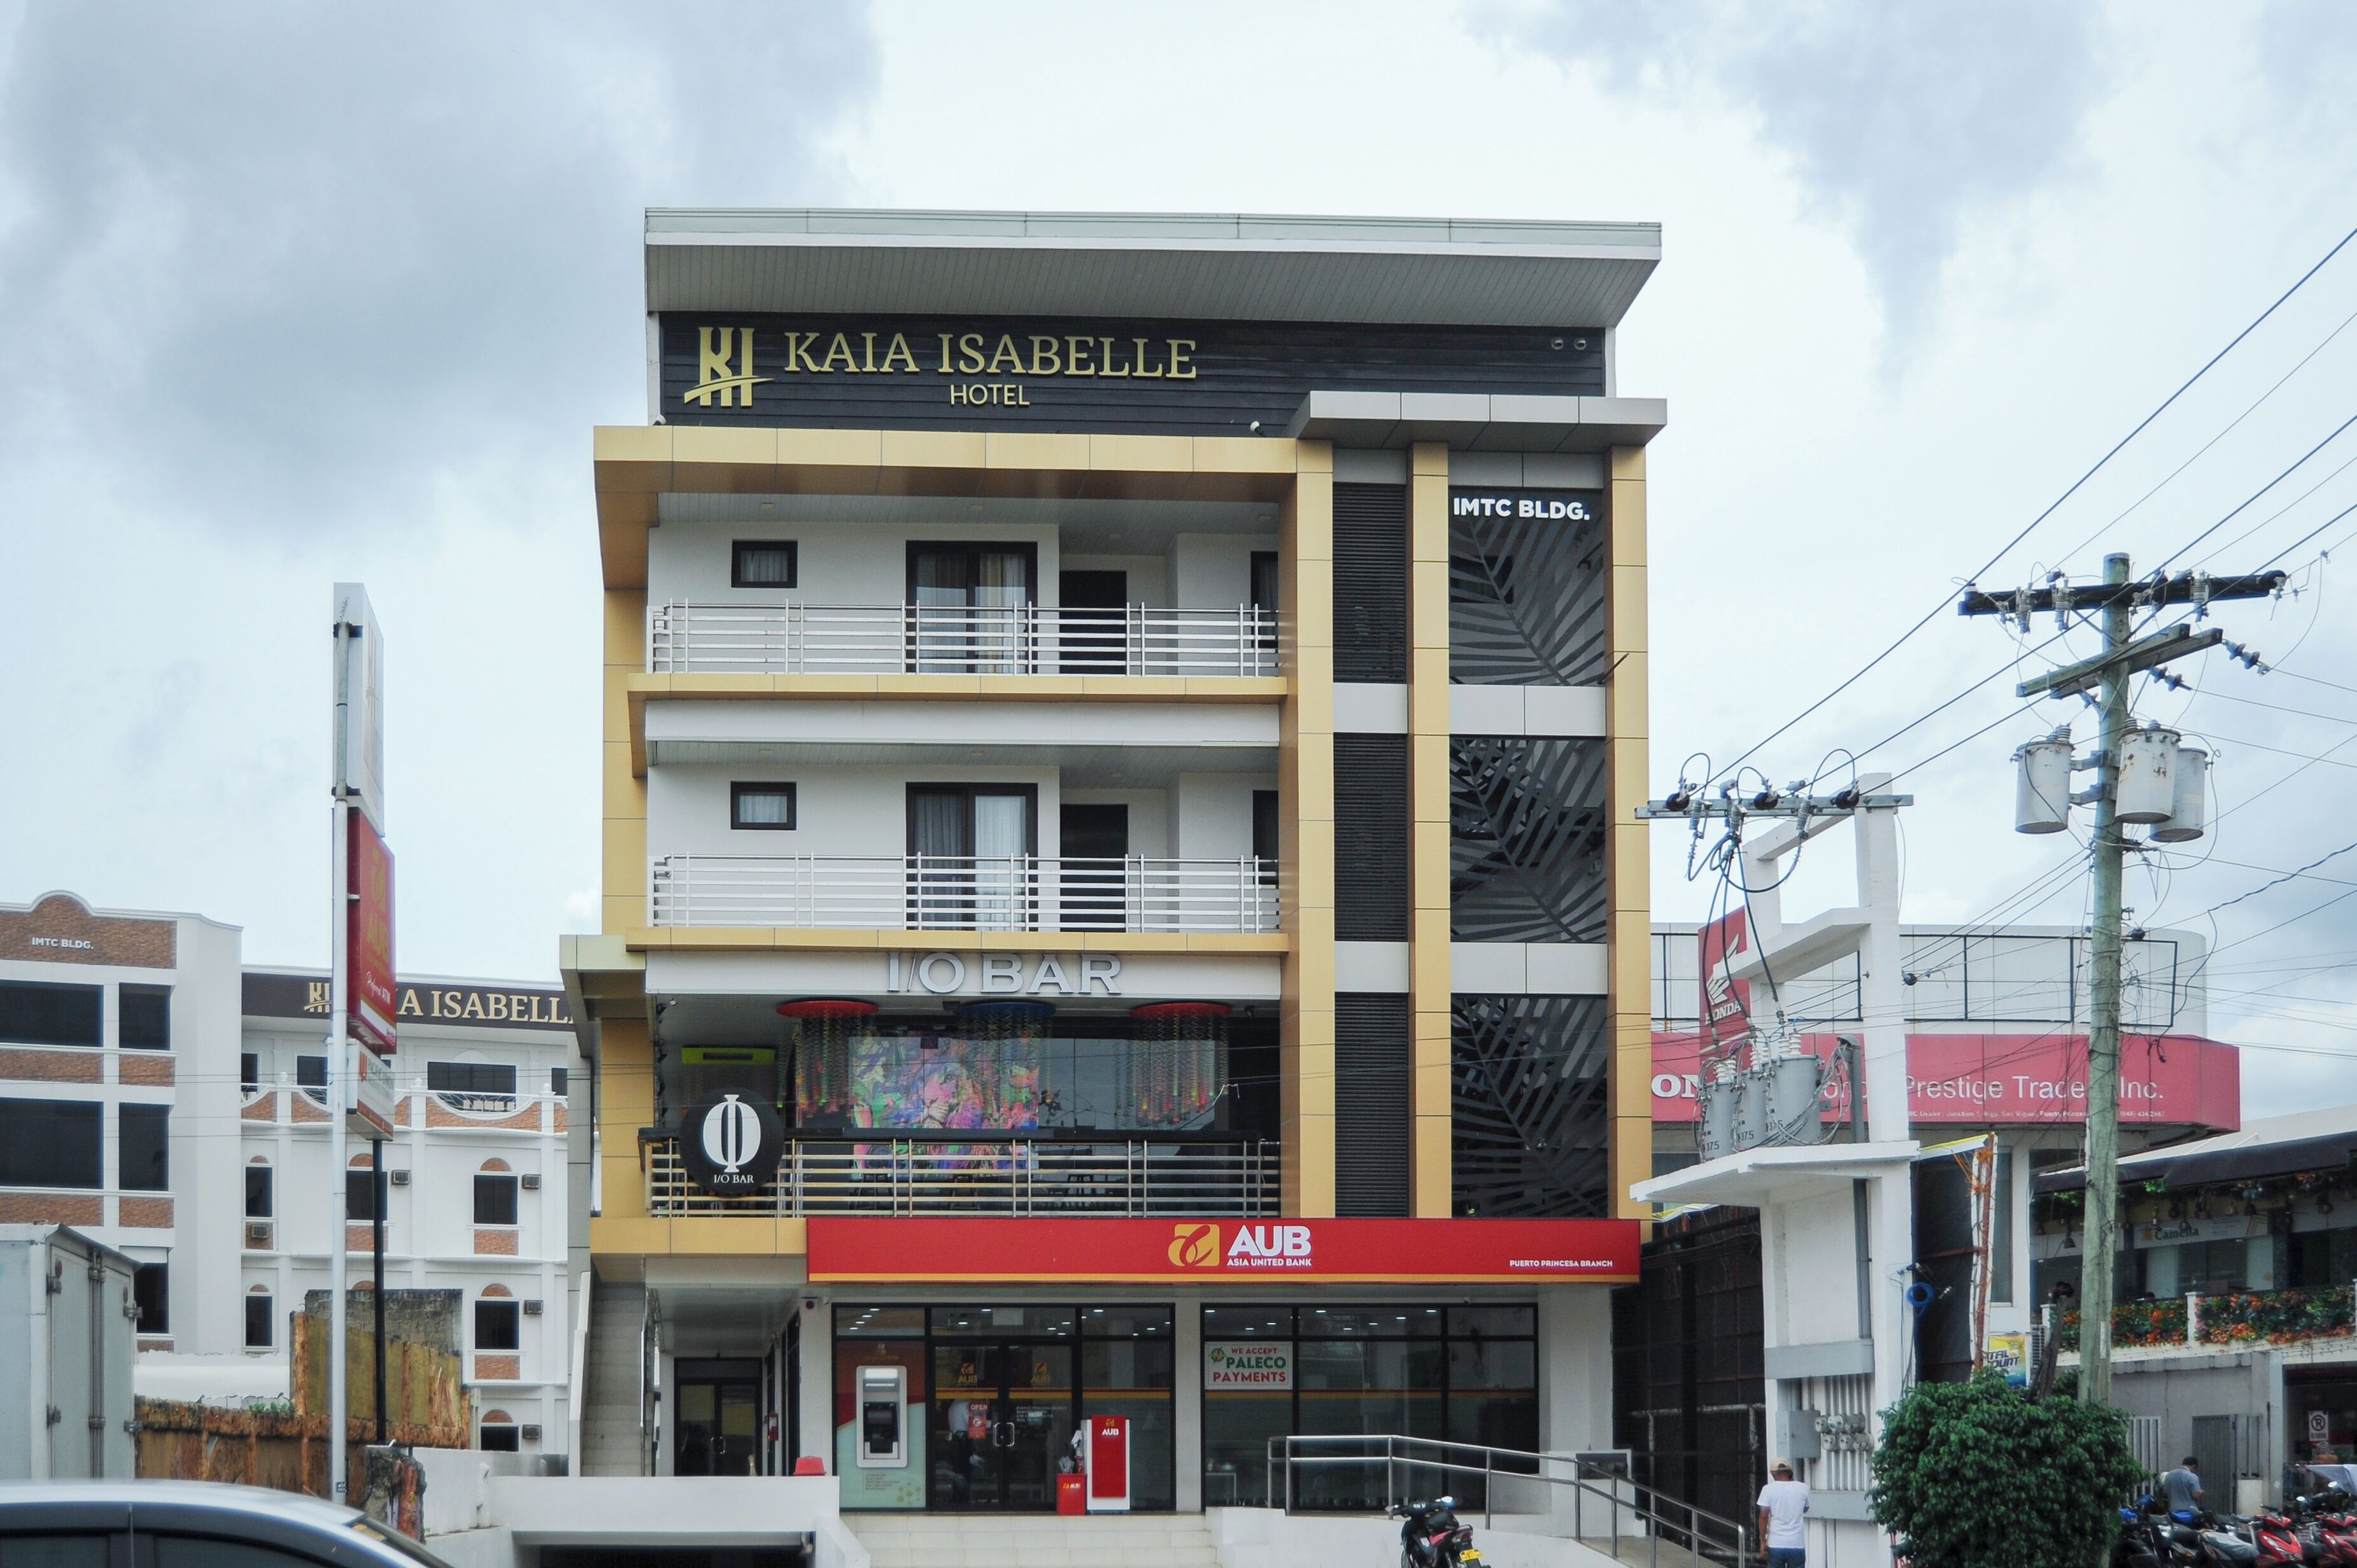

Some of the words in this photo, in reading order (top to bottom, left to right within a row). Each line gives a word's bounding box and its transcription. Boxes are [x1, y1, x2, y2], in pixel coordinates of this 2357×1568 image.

[784, 331, 920, 374] KAIA
[937, 333, 1198, 379] ISABELLE
[950, 384, 1030, 406] HOTEL
[1453, 497, 1512, 517] IMTC
[1518, 500, 1590, 521] BLDG.
[31, 936, 59, 947] IMTC
[60, 939, 94, 950] BLDG.
[887, 952, 965, 994] I/O
[980, 952, 1122, 995] BAR
[431, 990, 573, 1024] ISABELL
[2120, 1076, 2164, 1099] Inc.
[1706, 1141, 1720, 1152] 37.5
[713, 1174, 730, 1183] I/O
[732, 1174, 754, 1183] BAR
[1226, 1224, 1312, 1257] AUB
[1226, 1258, 1249, 1266] ASIA
[1250, 1258, 1284, 1266] UNITED
[1285, 1258, 1312, 1266] BANK
[1226, 1356, 1287, 1369] PALECO
[957, 1375, 979, 1383] AUB
[1213, 1371, 1286, 1383] PAYMENTS
